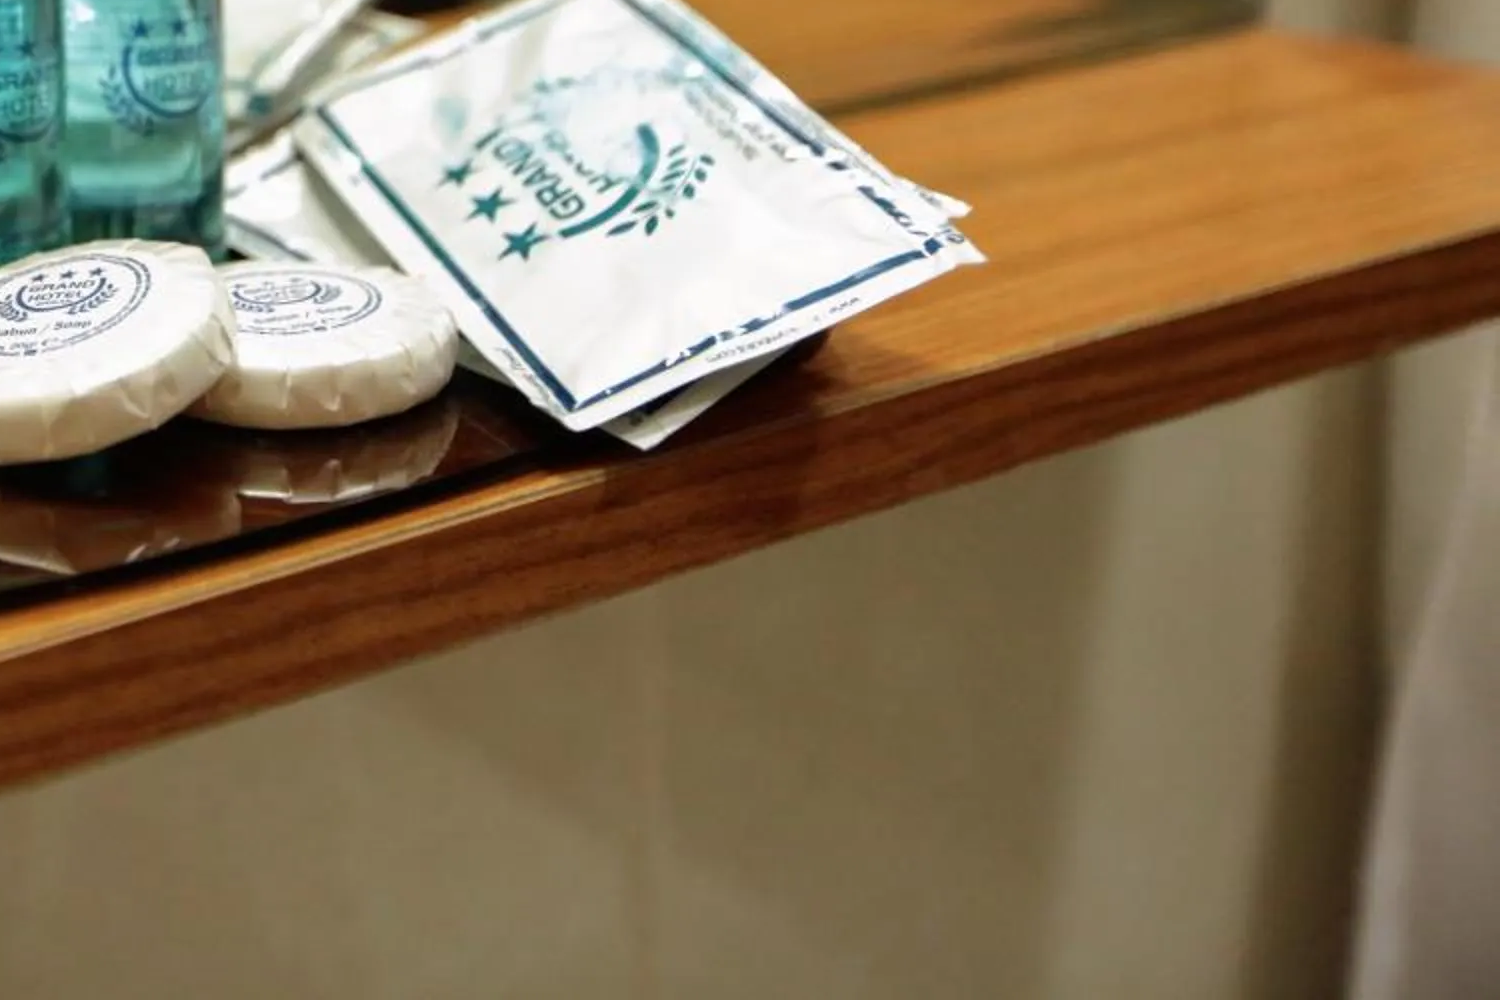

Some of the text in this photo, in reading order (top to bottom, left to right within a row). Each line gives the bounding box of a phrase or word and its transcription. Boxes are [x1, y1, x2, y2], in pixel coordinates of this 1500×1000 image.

[493, 136, 586, 220] GRAND
[28, 279, 96, 293] GRAND
[27, 289, 82, 302] HOTEL
